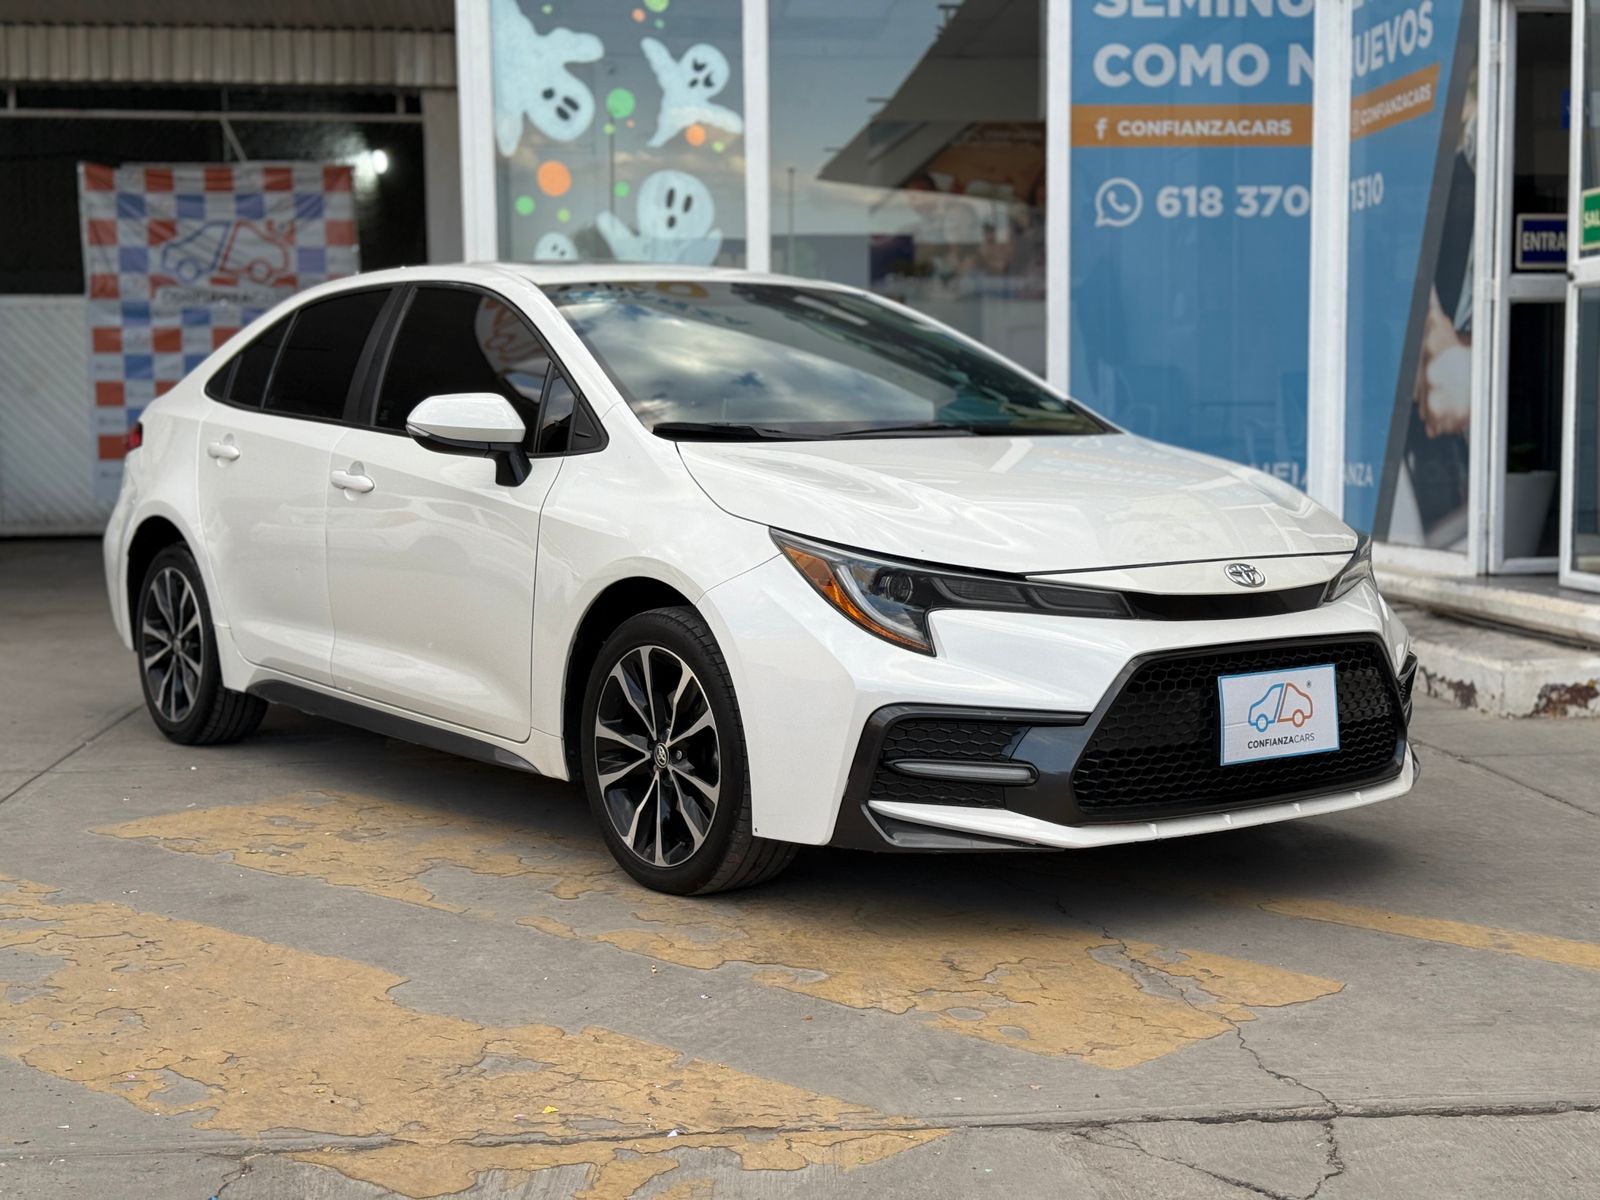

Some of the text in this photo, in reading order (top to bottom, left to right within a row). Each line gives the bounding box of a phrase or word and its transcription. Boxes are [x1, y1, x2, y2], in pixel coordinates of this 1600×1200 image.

[1093, 43, 1270, 87] COMO
[1117, 119, 1292, 137] CONFIANZACARS
[1156, 185, 1310, 218] 618 370
[1247, 732, 1315, 749] CONFIANZACARS
